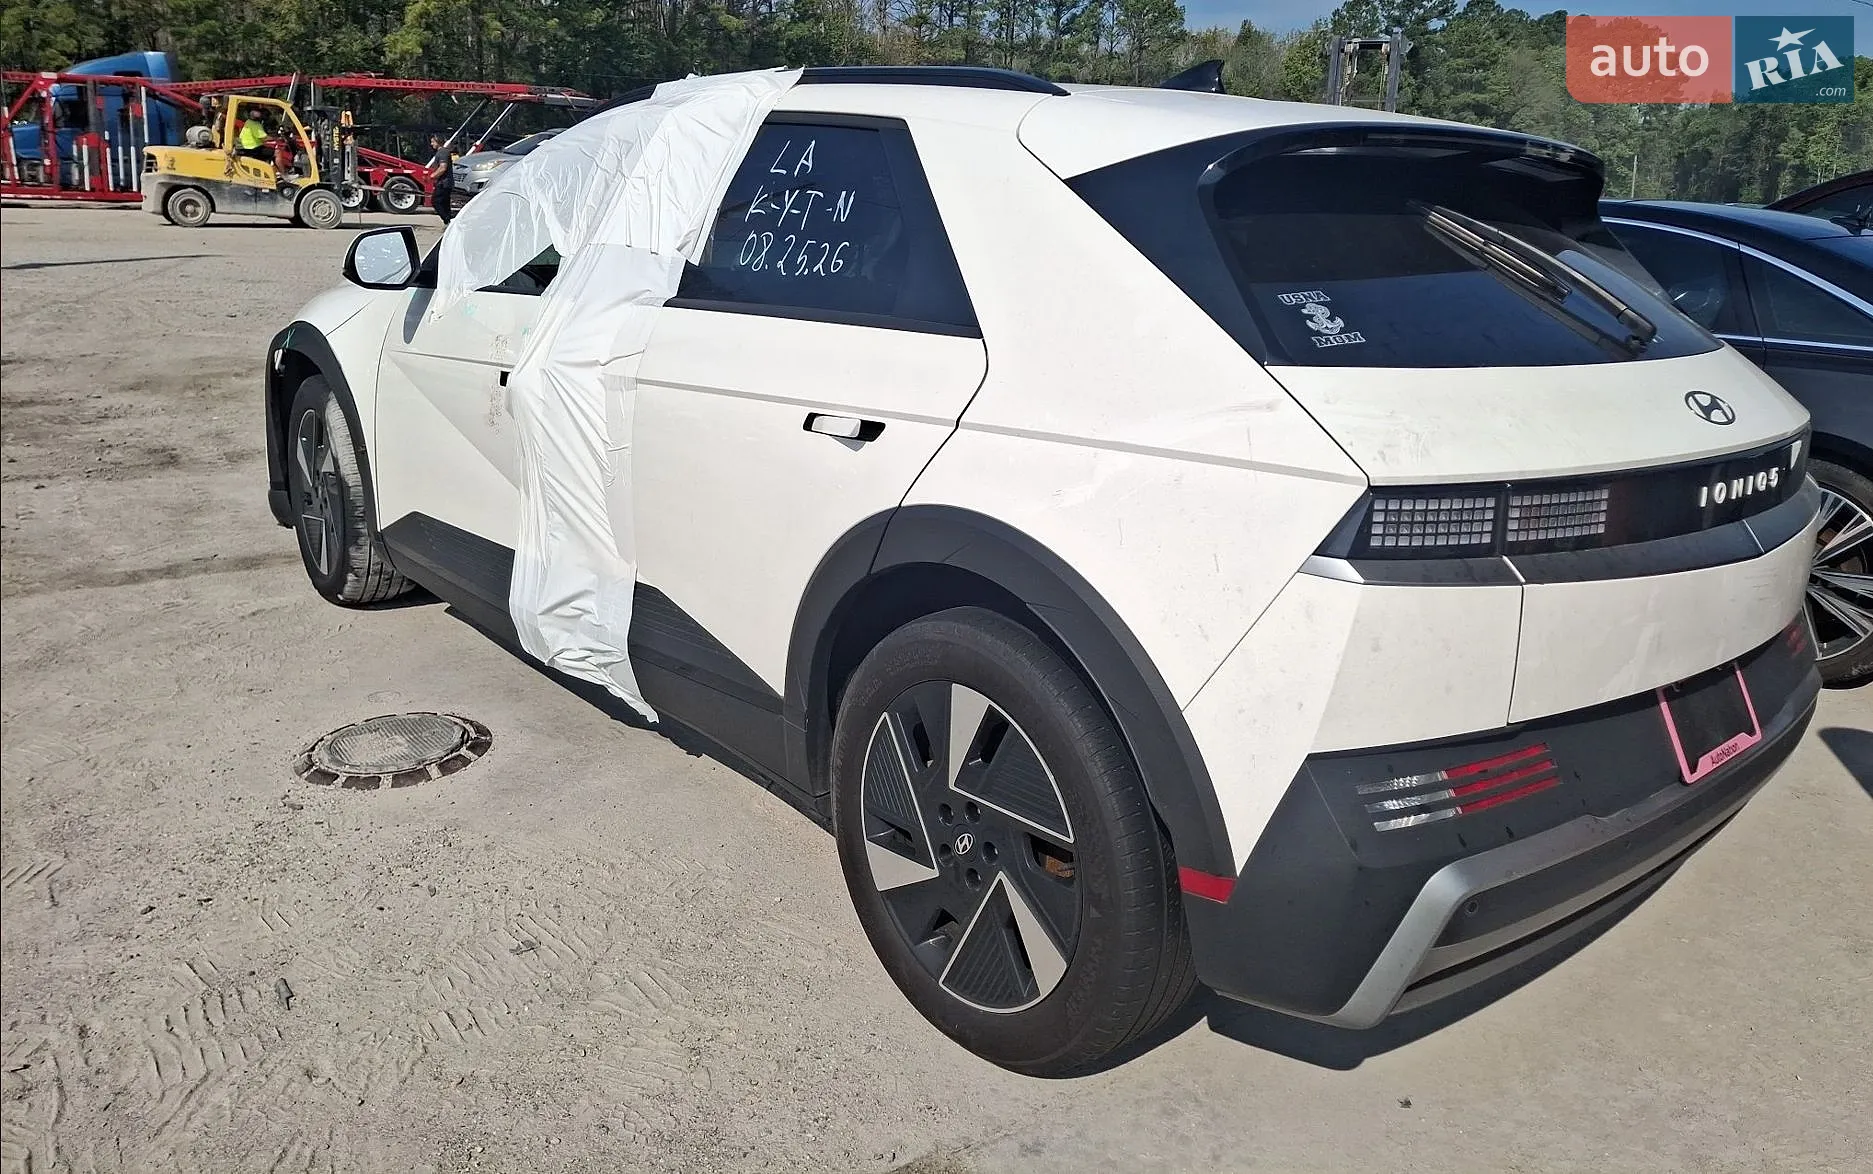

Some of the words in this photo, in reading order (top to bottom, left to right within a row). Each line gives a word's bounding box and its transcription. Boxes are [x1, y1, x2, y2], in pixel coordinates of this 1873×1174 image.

[769, 139, 816, 178] LA
[744, 184, 857, 231] K-Y-T-N
[1277, 290, 1332, 306] USNA
[1311, 331, 1367, 348] MOM
